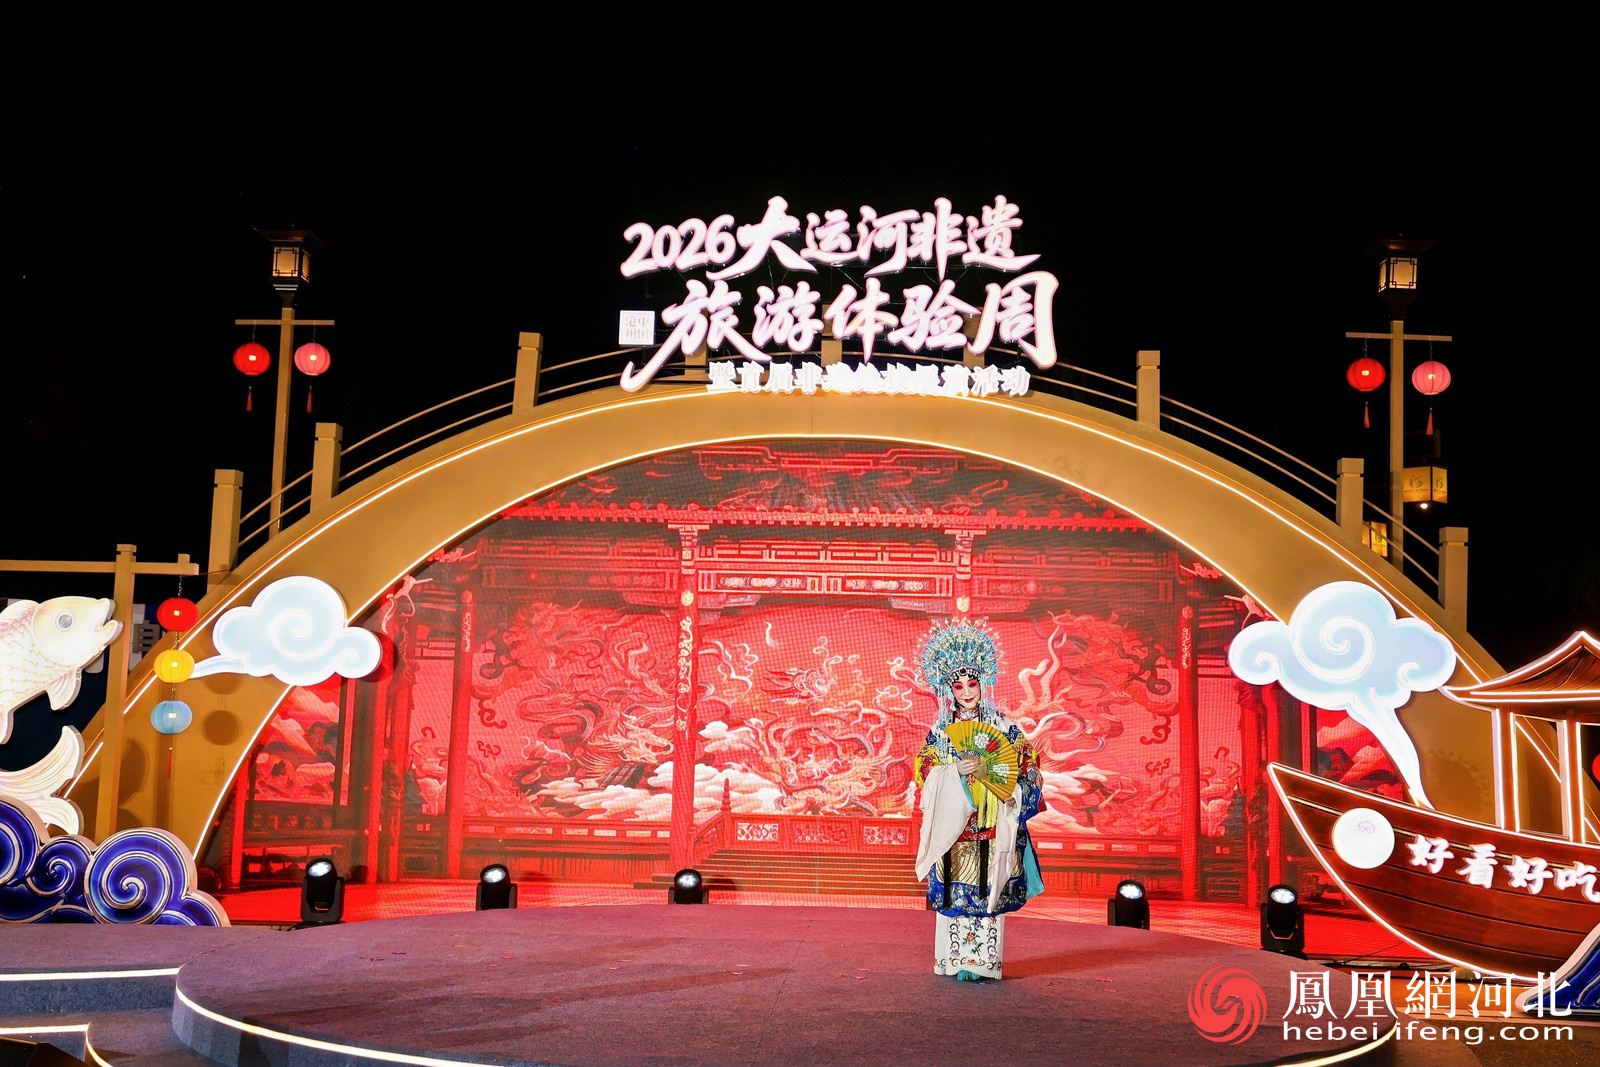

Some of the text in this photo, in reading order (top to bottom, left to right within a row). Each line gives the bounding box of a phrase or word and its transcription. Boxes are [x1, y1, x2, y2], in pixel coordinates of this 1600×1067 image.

[619, 195, 1041, 281] 2026大运河非遗
[619, 271, 1060, 392] 旅游体验周
[1405, 834, 1600, 904] 好看好吃
